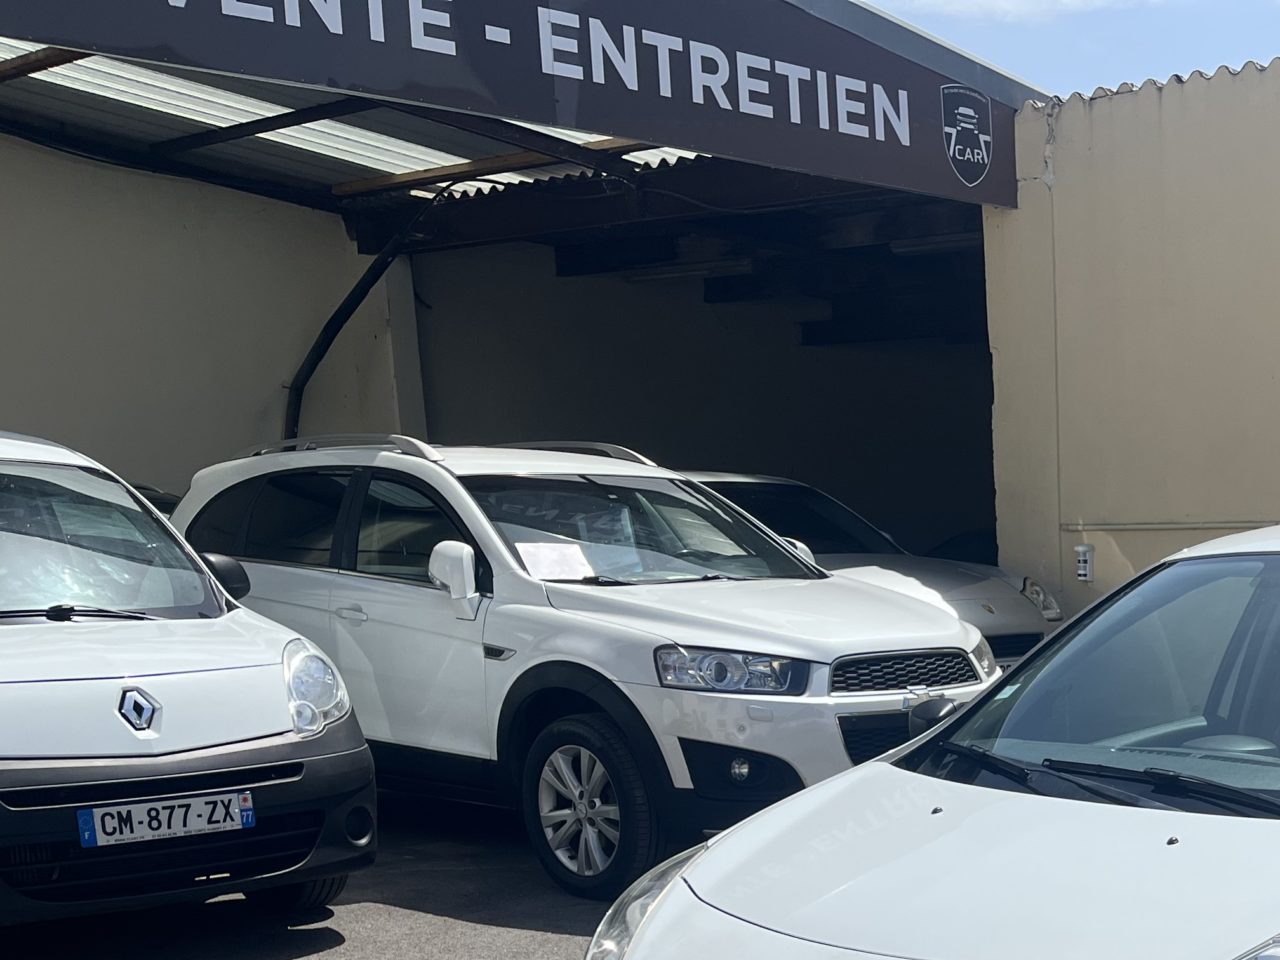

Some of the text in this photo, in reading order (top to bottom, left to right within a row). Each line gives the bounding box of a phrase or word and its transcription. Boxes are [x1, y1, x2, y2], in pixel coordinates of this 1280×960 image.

[537, 6, 911, 147] ENTRETIEN
[100, 799, 235, 836] CM-877-ZX
[241, 811, 253, 823] 77
